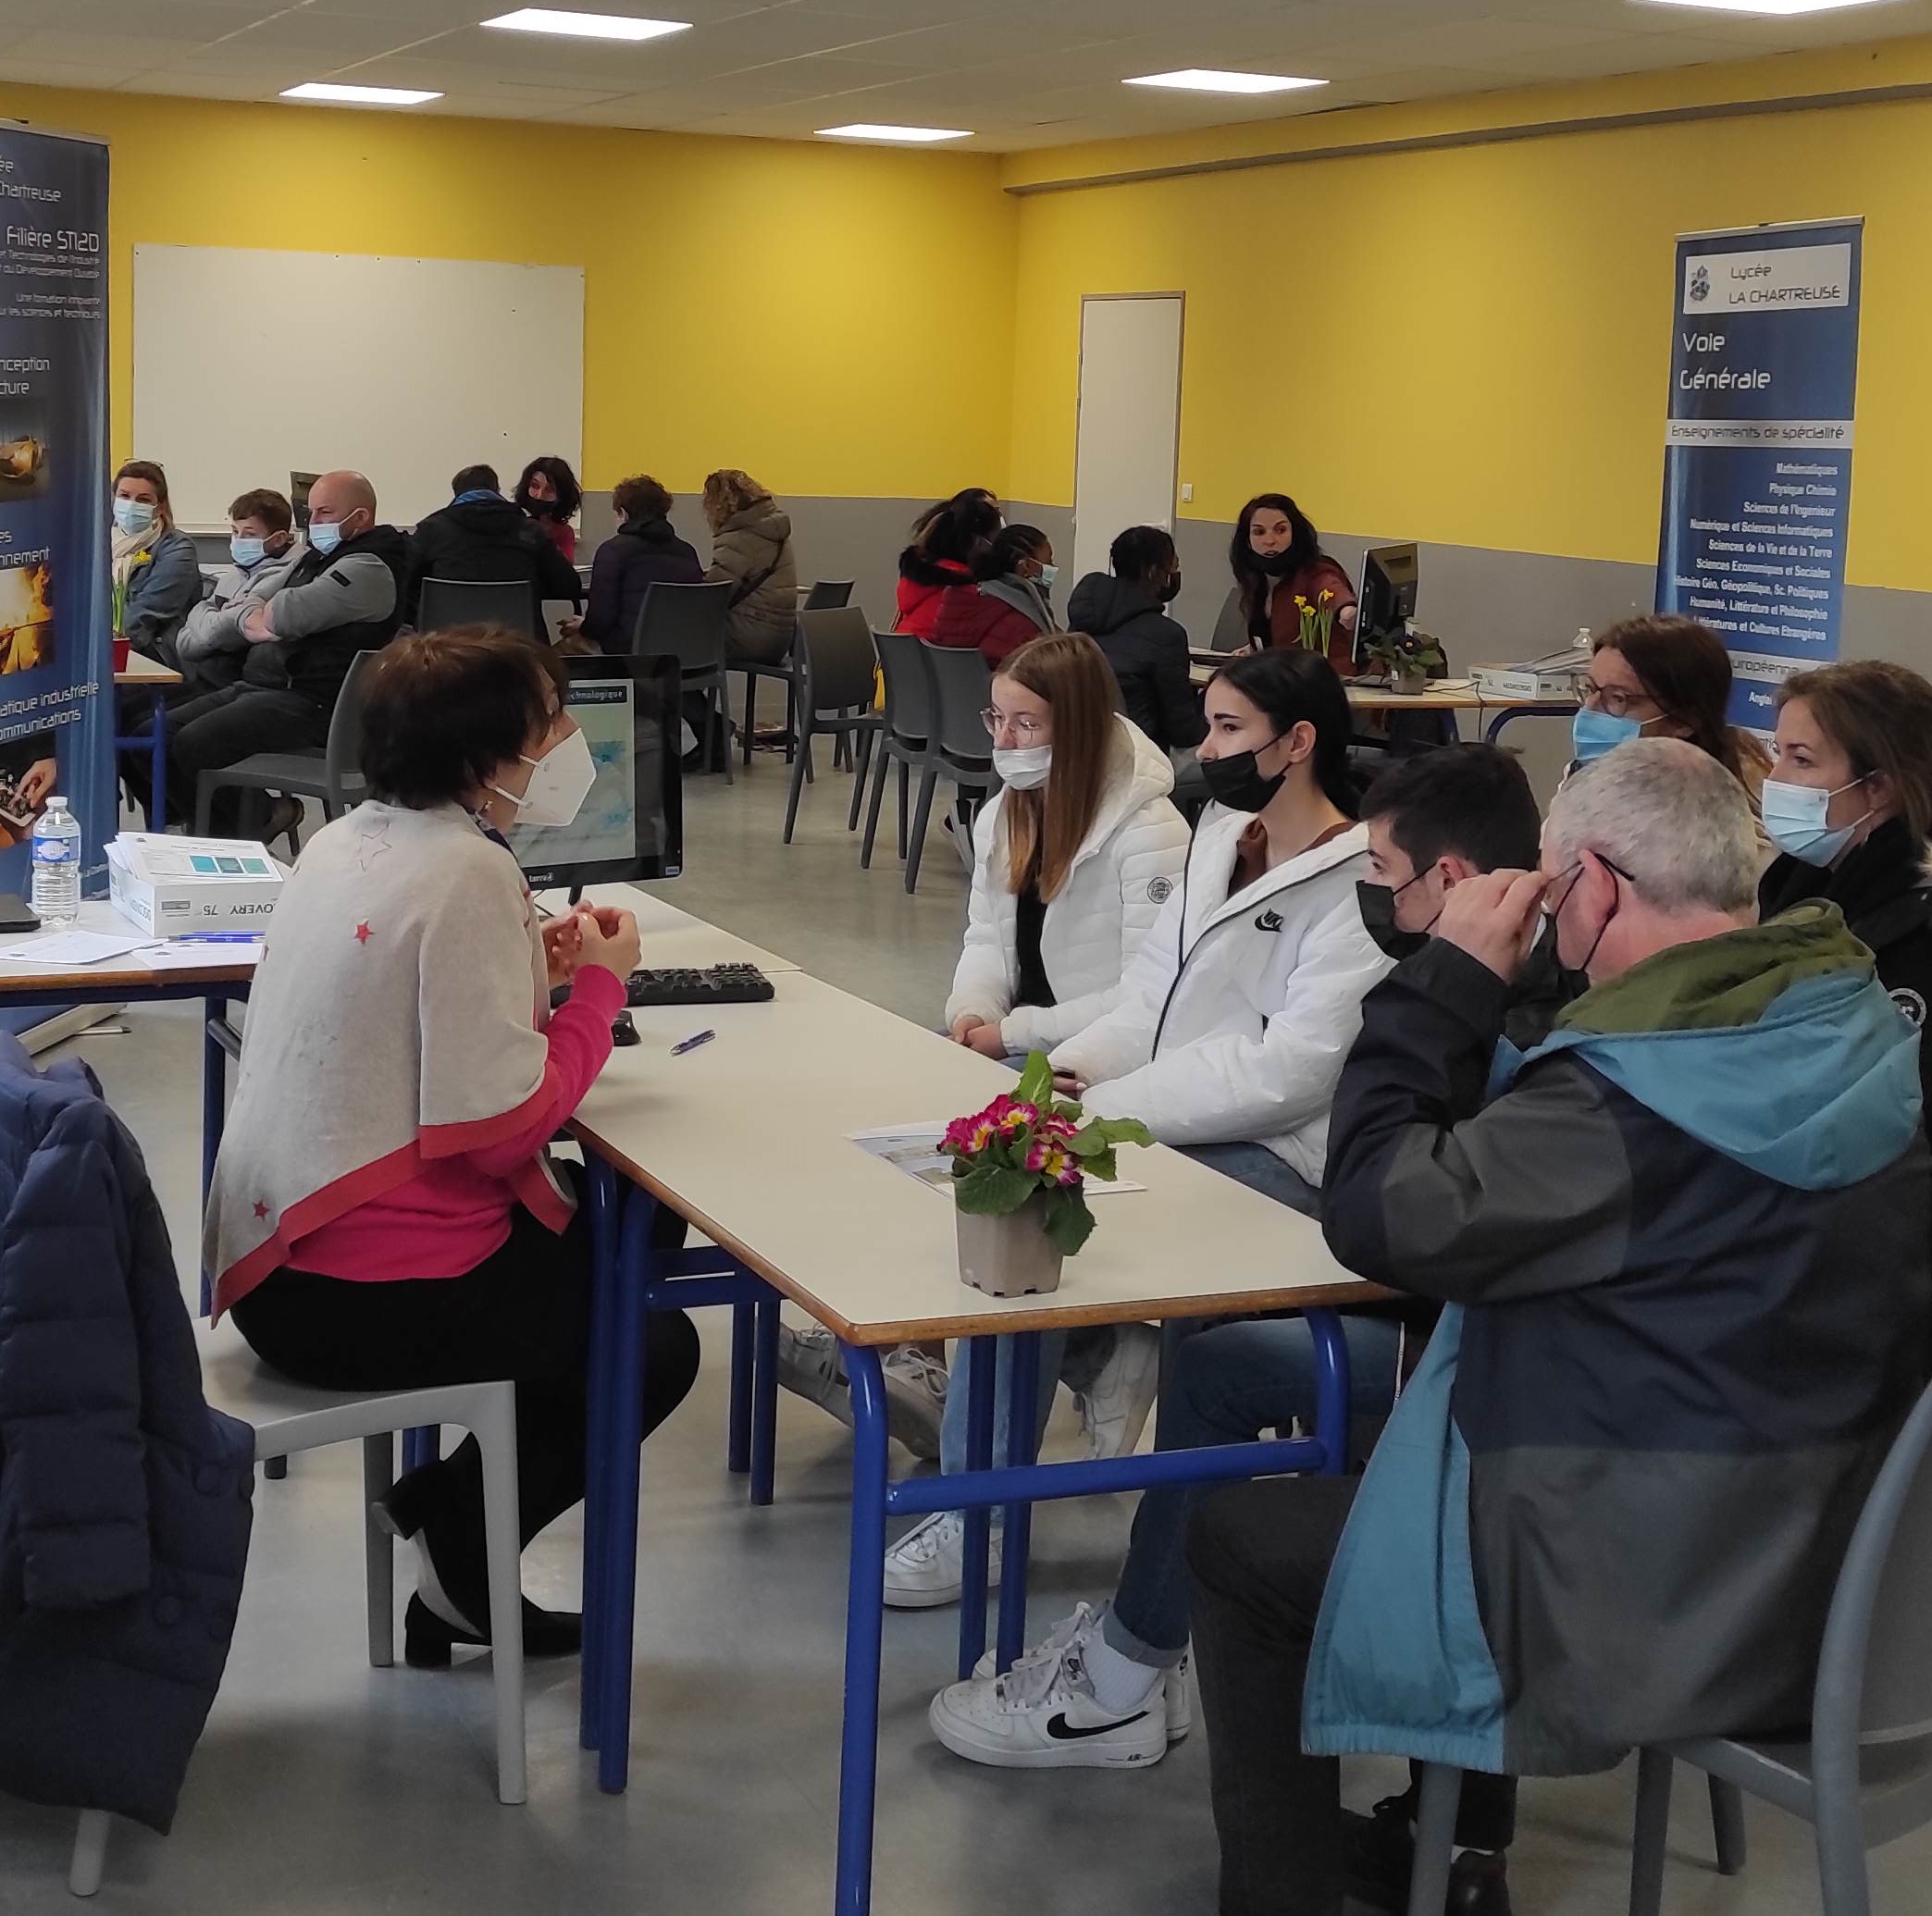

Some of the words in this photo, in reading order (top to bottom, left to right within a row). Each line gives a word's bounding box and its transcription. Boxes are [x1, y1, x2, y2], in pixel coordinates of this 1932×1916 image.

[6, 226, 53, 248] Filière
[56, 229, 100, 252] STI2D
[1730, 263, 1772, 280] Lycée
[1728, 290, 1746, 304] LA
[1749, 285, 1840, 303] CHARTREUSE
[1682, 332, 1726, 352] Voie
[1679, 366, 1771, 389] Générale
[1671, 425, 1761, 439] Enseignements
[1764, 426, 1779, 439] de
[1782, 424, 1845, 440] spécialité
[1776, 462, 1839, 477] Mathématiques
[1769, 482, 1805, 497] Physique
[1806, 484, 1837, 497] Chimie
[1743, 501, 1778, 514] Sciences
[1779, 503, 1790, 515] de
[1690, 518, 1730, 534] Numérique
[1731, 521, 1740, 532] et
[1741, 521, 1777, 535] Sciences
[1777, 524, 1834, 539] Informatiques
[1708, 538, 1744, 552] Sciences
[1745, 541, 1756, 553] de
[1757, 542, 1765, 553] la
[1765, 542, 1777, 555] Vie
[1799, 545, 1807, 557] la
[1808, 545, 1833, 559] Terre
[1696, 557, 1730, 572] Sciences
[1785, 565, 1793, 576] et
[1794, 564, 1831, 579] Sociales
[1787, 586, 1829, 600] Politiques
[1771, 603, 1778, 615] et
[1779, 604, 1828, 622] Philosophie
[1739, 620, 1748, 632] et
[1749, 621, 1780, 636] Cultures
[40, 682, 100, 707] industrielle
[1748, 691, 1773, 707] Angla
[203, 905, 219, 916] 75
